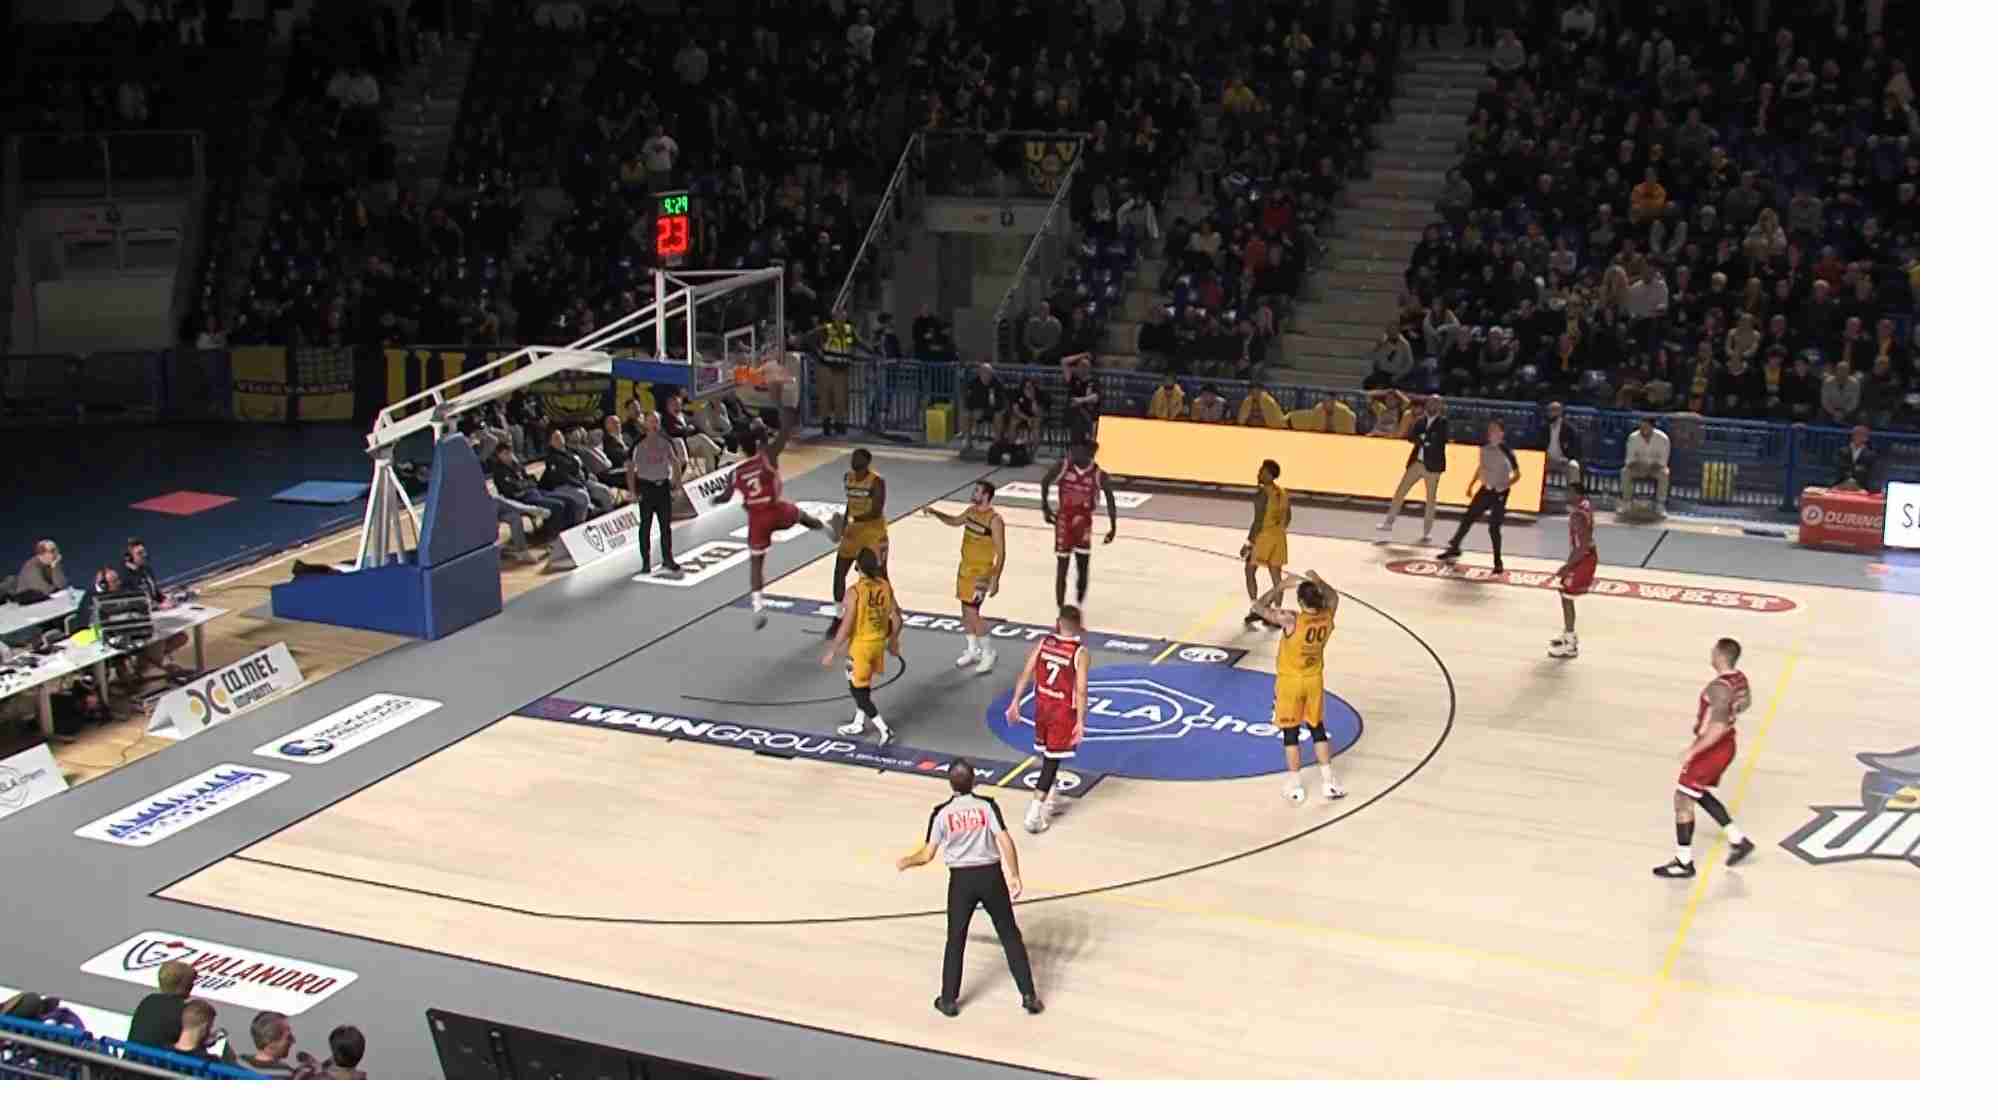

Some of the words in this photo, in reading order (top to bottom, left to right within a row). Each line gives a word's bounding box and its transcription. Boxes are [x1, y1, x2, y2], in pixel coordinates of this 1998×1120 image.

[656, 217, 688, 254] 23
[746, 477, 763, 497] 3
[1824, 510, 1883, 529] DURING
[1902, 502, 1920, 529] S
[1305, 624, 1328, 644] 00
[1046, 661, 1060, 685] 7
[569, 704, 856, 755] MAINGROUP
[192, 951, 336, 995] VALANDRO
